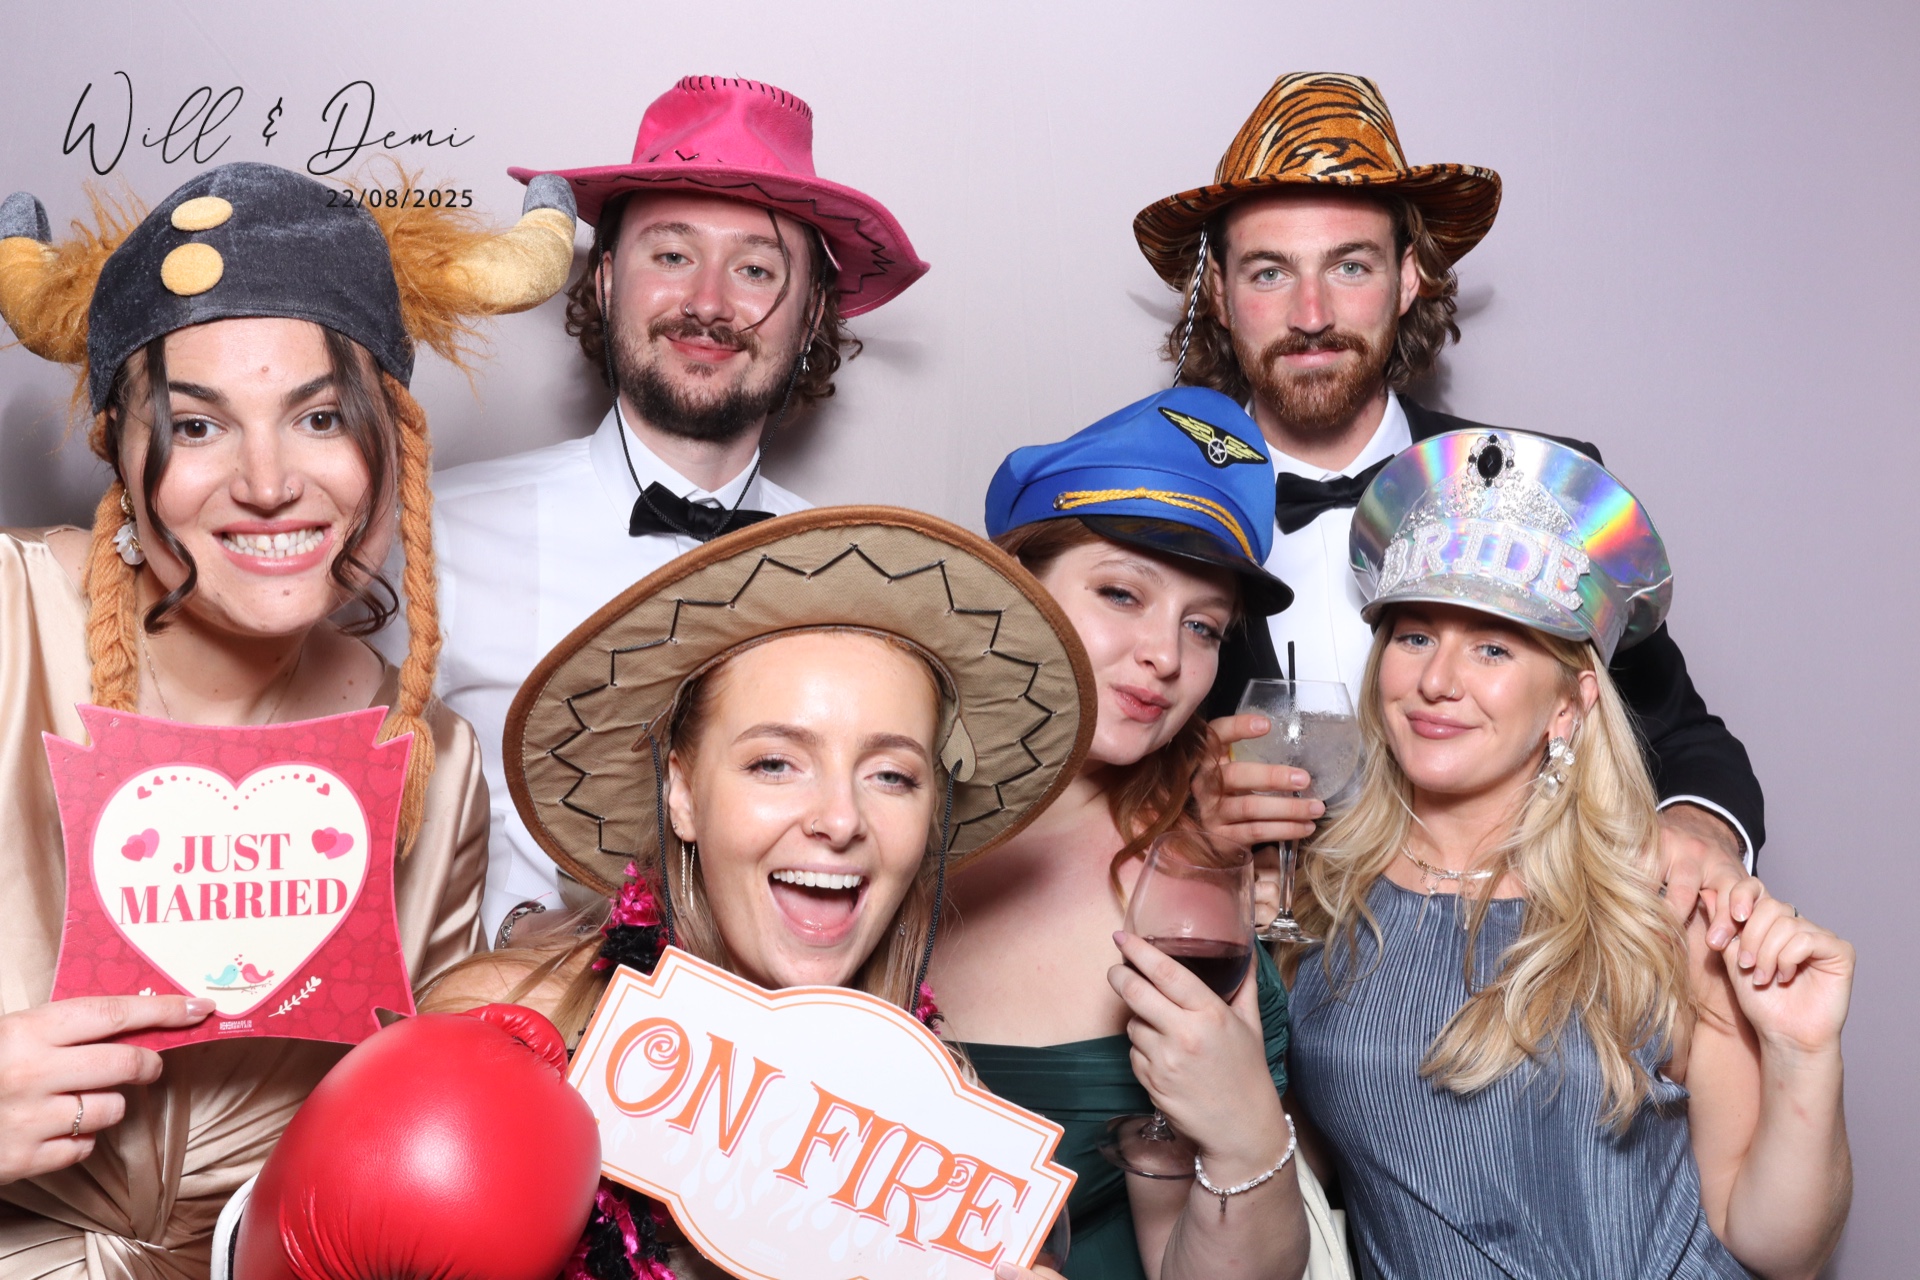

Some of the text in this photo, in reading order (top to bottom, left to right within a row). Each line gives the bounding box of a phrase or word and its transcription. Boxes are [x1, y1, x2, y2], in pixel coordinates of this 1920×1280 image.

[1377, 521, 1590, 611] BRIDE
[173, 833, 290, 874] JUST
[119, 878, 348, 924] MARRIED
[605, 1017, 1031, 1269] ON FIRE
